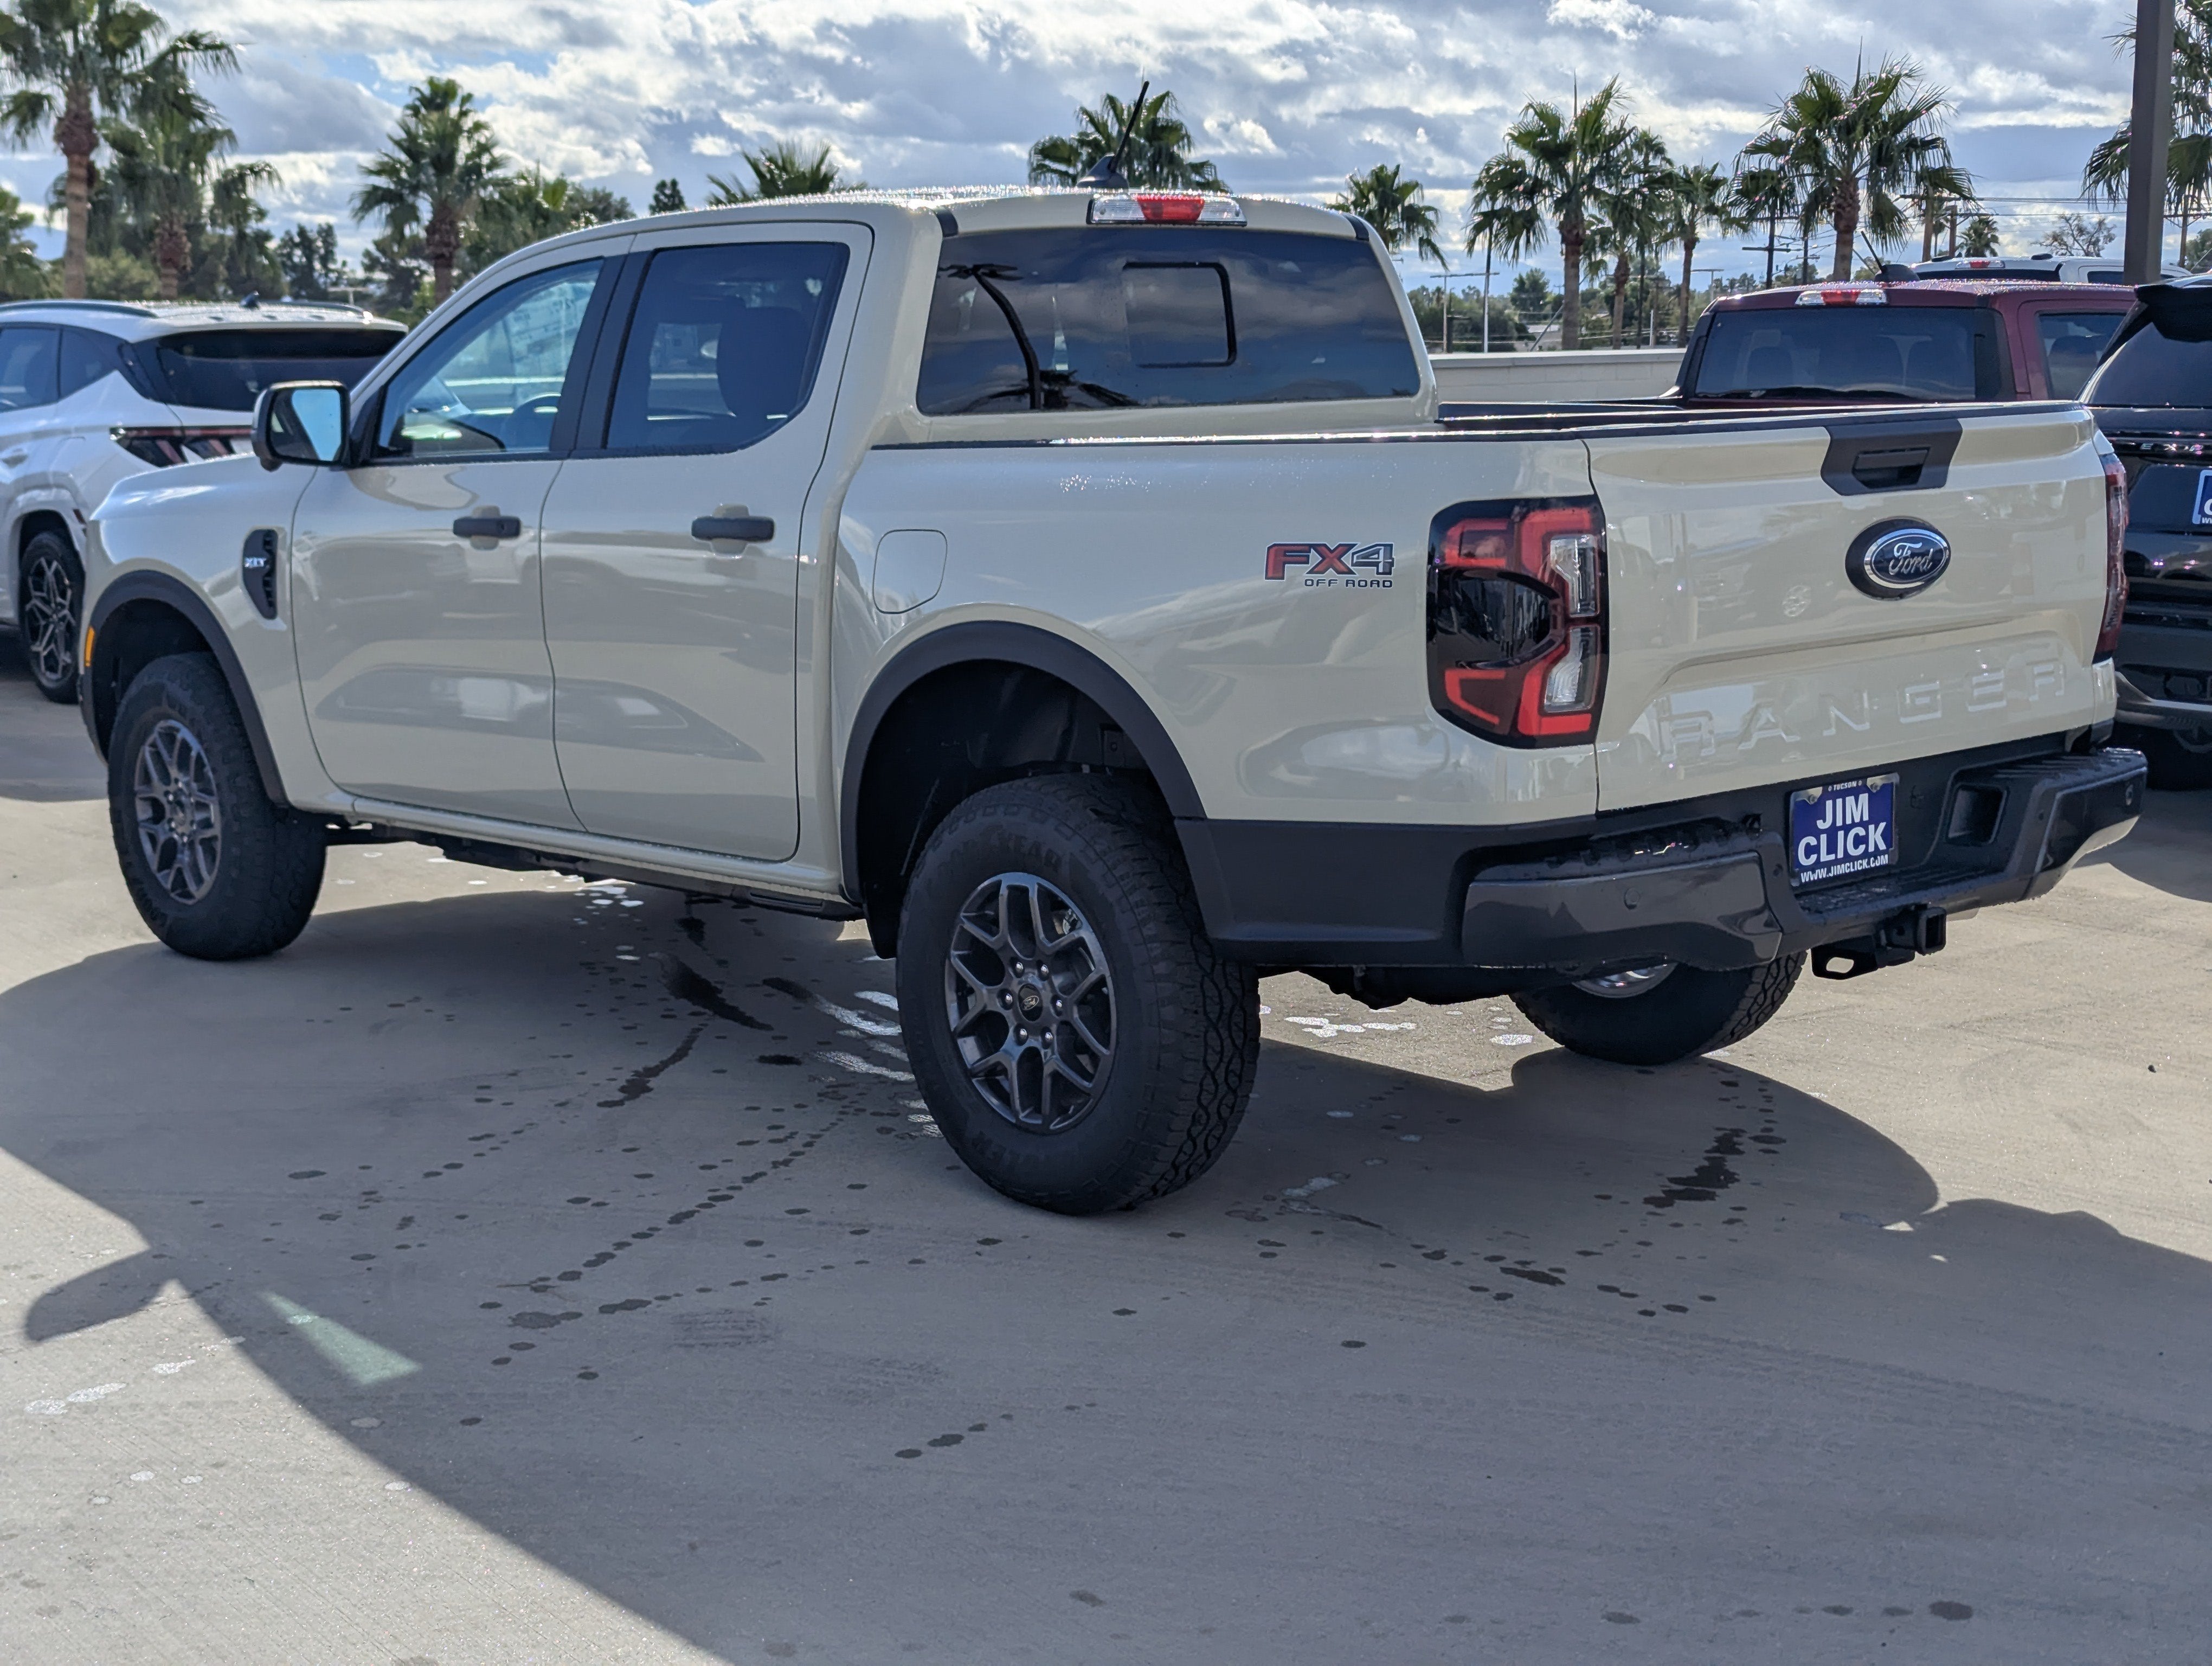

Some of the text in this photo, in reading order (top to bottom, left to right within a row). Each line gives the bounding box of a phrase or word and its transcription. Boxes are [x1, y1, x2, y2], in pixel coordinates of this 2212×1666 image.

[1264, 542, 1396, 581] FX4
[1889, 542, 1933, 575] Ford
[1304, 579, 1393, 588] OFF ROAD
[1657, 659, 2067, 763] RANGER
[1833, 781, 1857, 791] TUCSON
[1816, 793, 1869, 830] JIM
[1798, 822, 1887, 866] CLICK
[1801, 855, 1888, 882] WWW.JIMCLICK.COM
